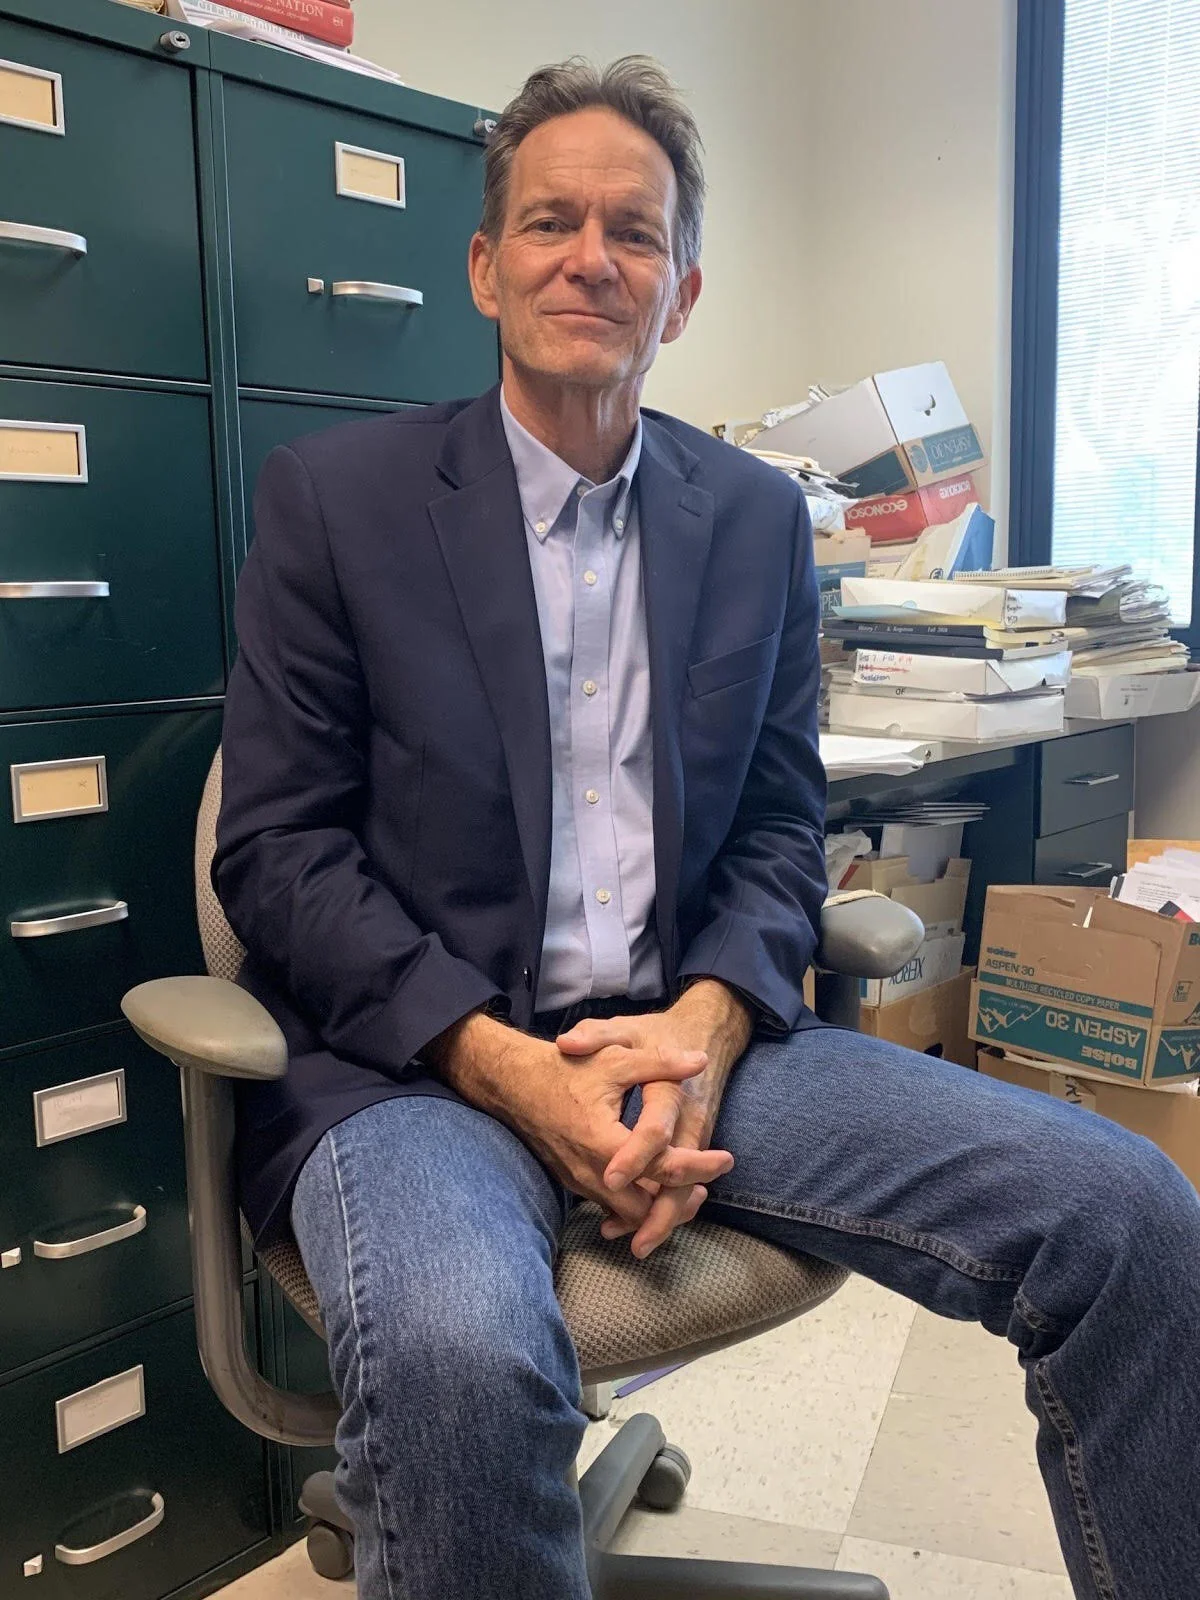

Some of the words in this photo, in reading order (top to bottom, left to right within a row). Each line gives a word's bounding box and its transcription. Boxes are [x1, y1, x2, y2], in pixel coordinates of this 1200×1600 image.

[276, 0, 325, 18] NATION
[985, 958, 1020, 975] ASPEN
[1020, 965, 1035, 977] 30
[1039, 984, 1075, 1001] RECYCLED
[1075, 992, 1096, 1006] COPY
[1096, 996, 1121, 1010] PAPER
[1045, 1010, 1070, 1031] 30
[1074, 1017, 1141, 1049] ASPEN
